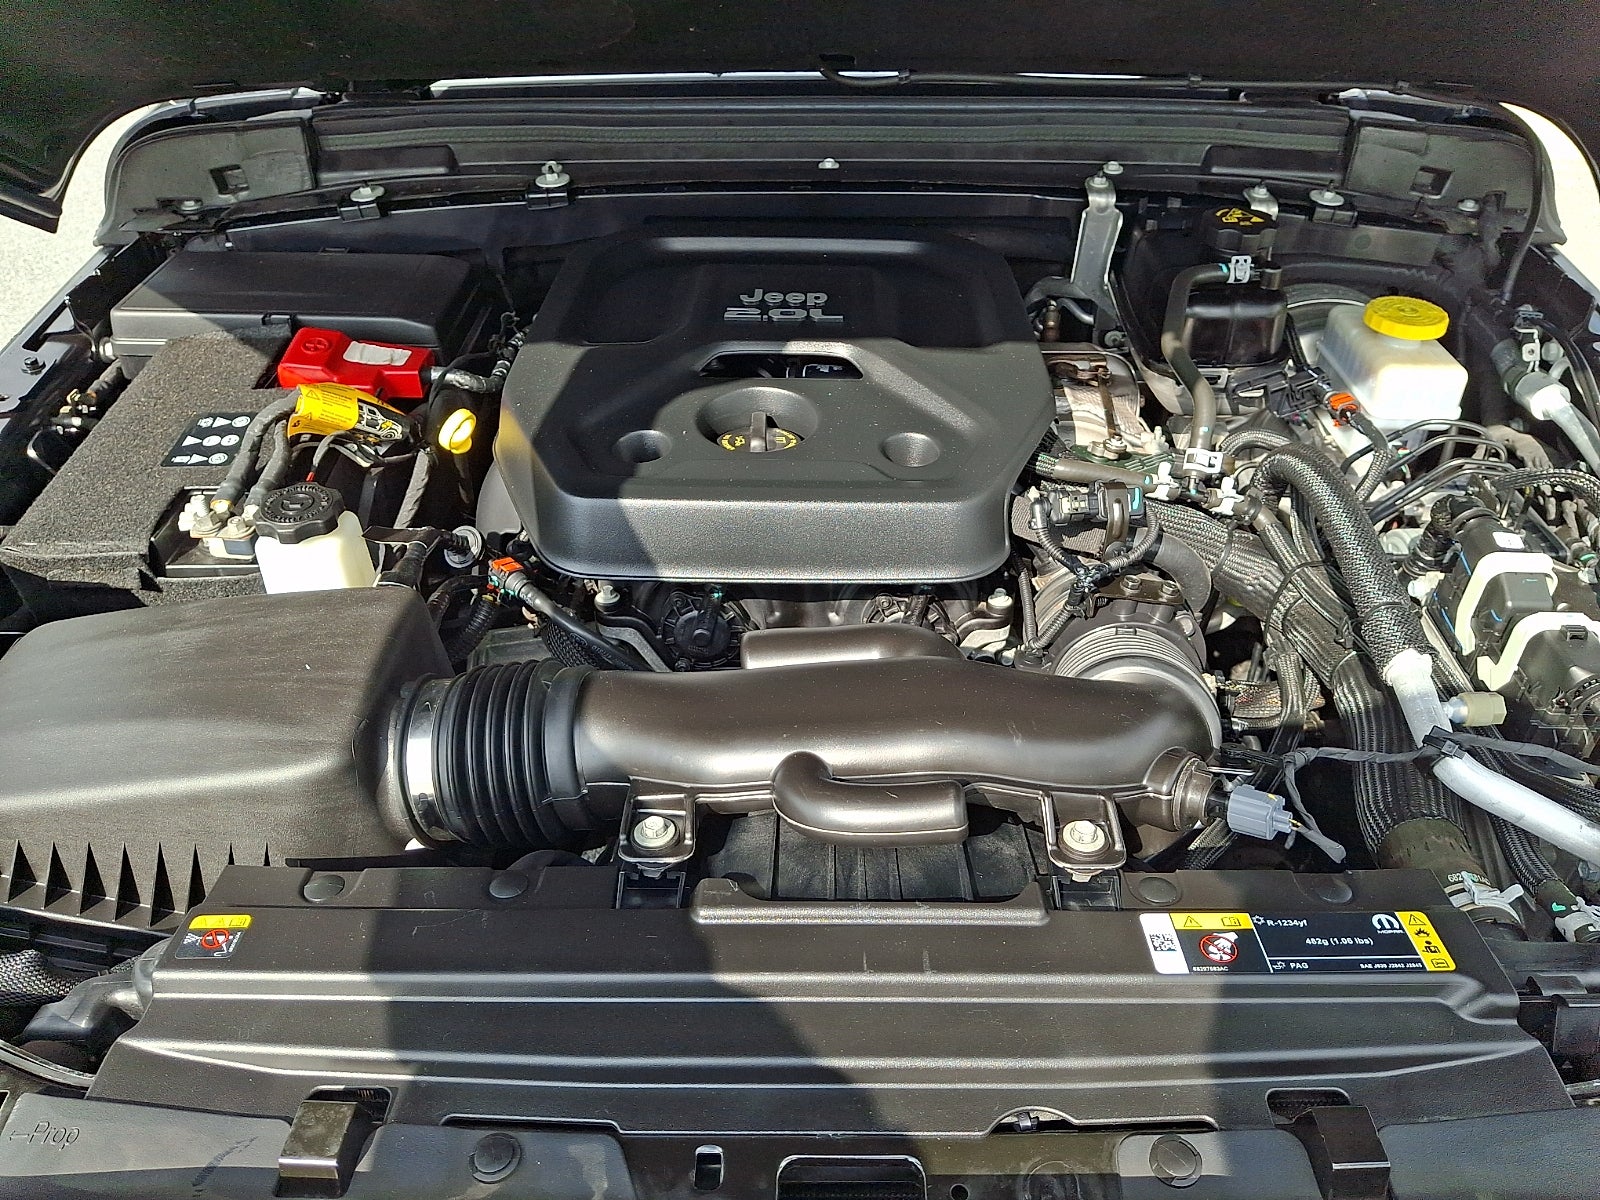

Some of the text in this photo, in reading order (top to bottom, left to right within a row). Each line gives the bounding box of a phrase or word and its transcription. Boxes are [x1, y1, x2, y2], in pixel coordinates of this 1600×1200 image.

[740, 289, 828, 306] Jeep
[724, 307, 844, 322] 2.0L
[1289, 962, 1309, 970] PAG
[28, 1121, 80, 1151] Prop
